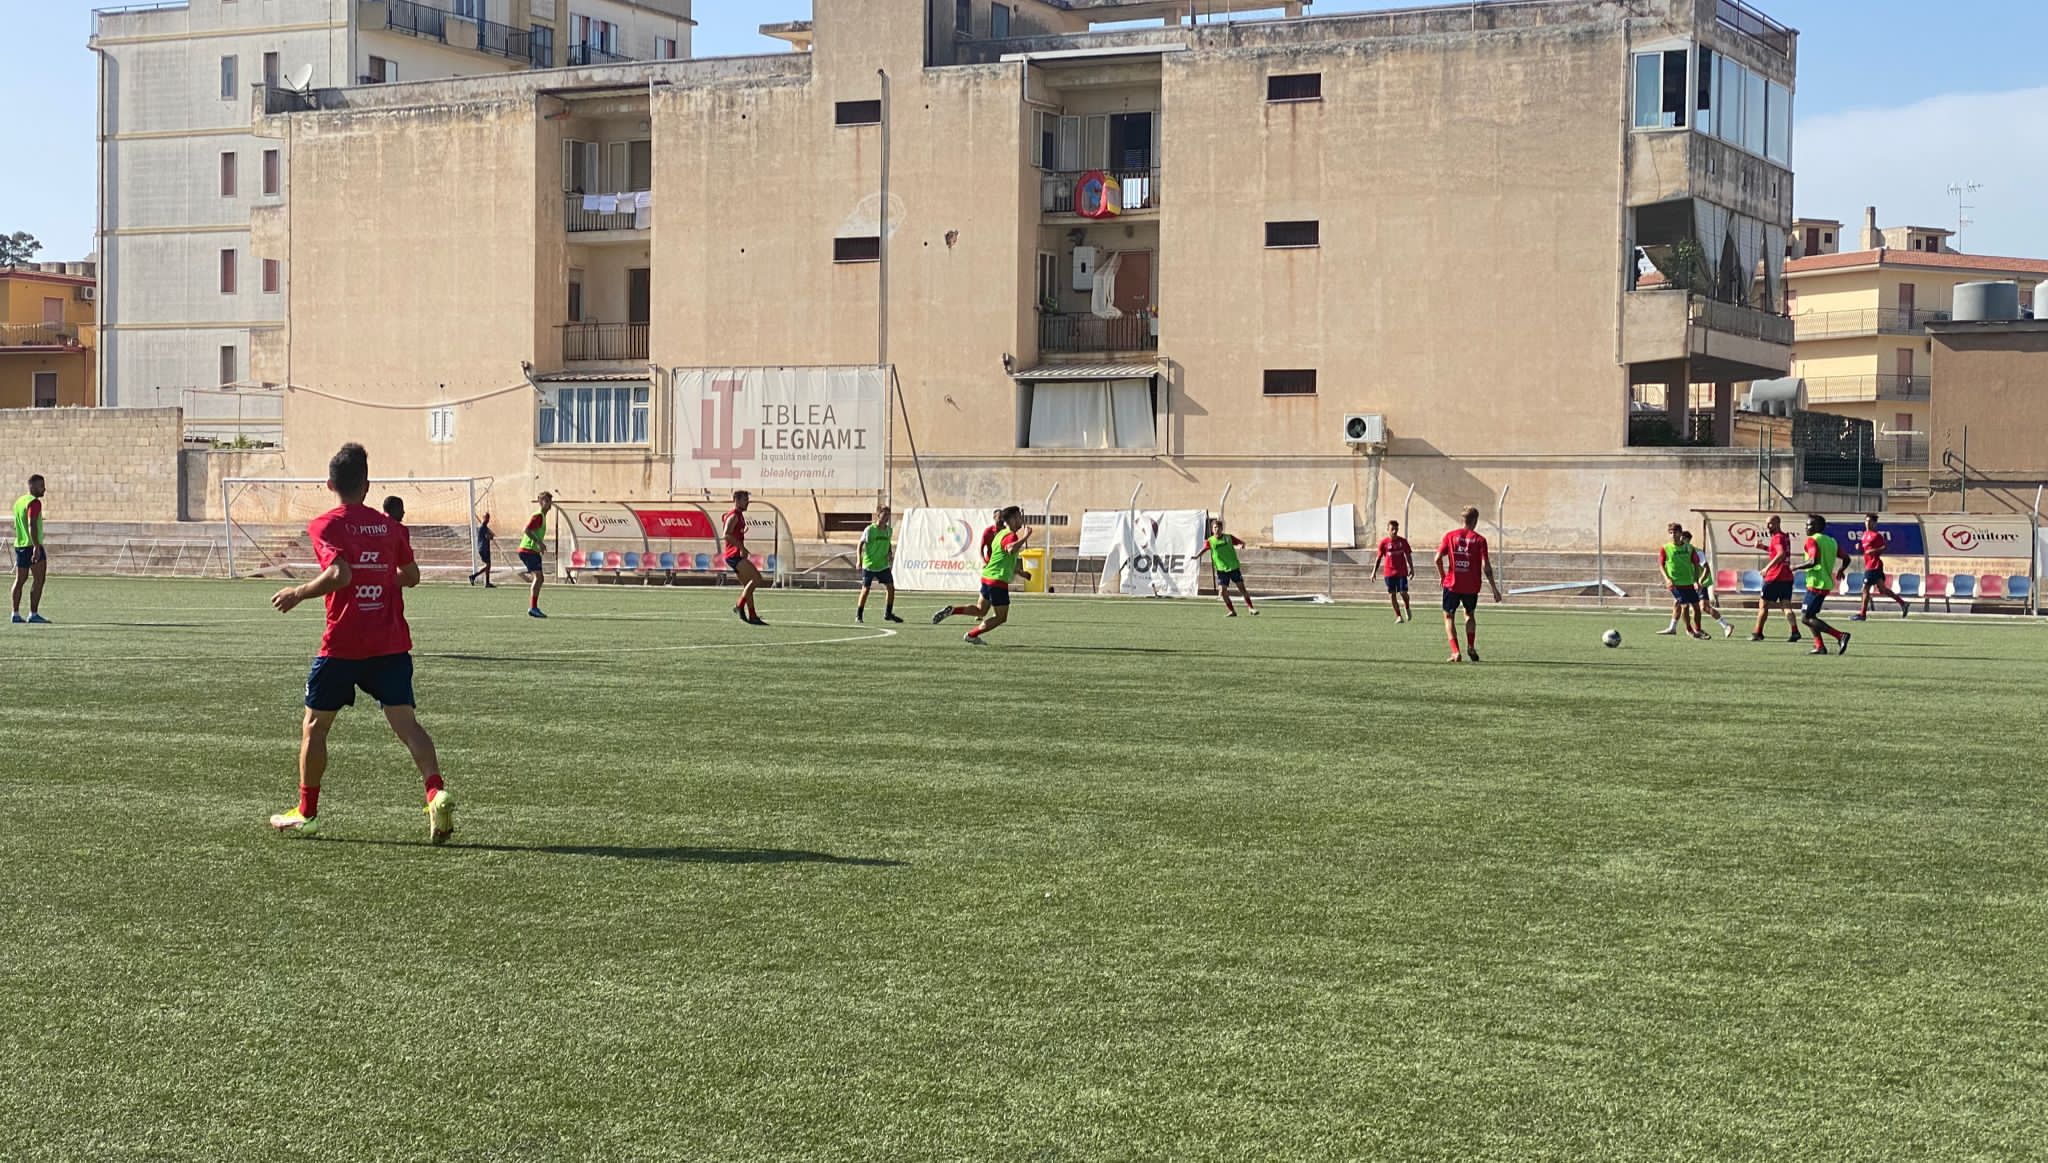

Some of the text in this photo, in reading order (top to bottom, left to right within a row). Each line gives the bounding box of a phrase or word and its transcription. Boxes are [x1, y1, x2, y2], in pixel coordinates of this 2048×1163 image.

[761, 404, 837, 425] IBLEA
[761, 429, 867, 449] LEGNAMI
[761, 452, 768, 461] la
[797, 452, 810, 461] nel
[811, 452, 833, 463] legno
[760, 467, 835, 481] iblealegnami.it
[658, 518, 693, 527] LOCALI
[1847, 530, 1892, 541] OSTI
[1133, 554, 1186, 573] ONE
